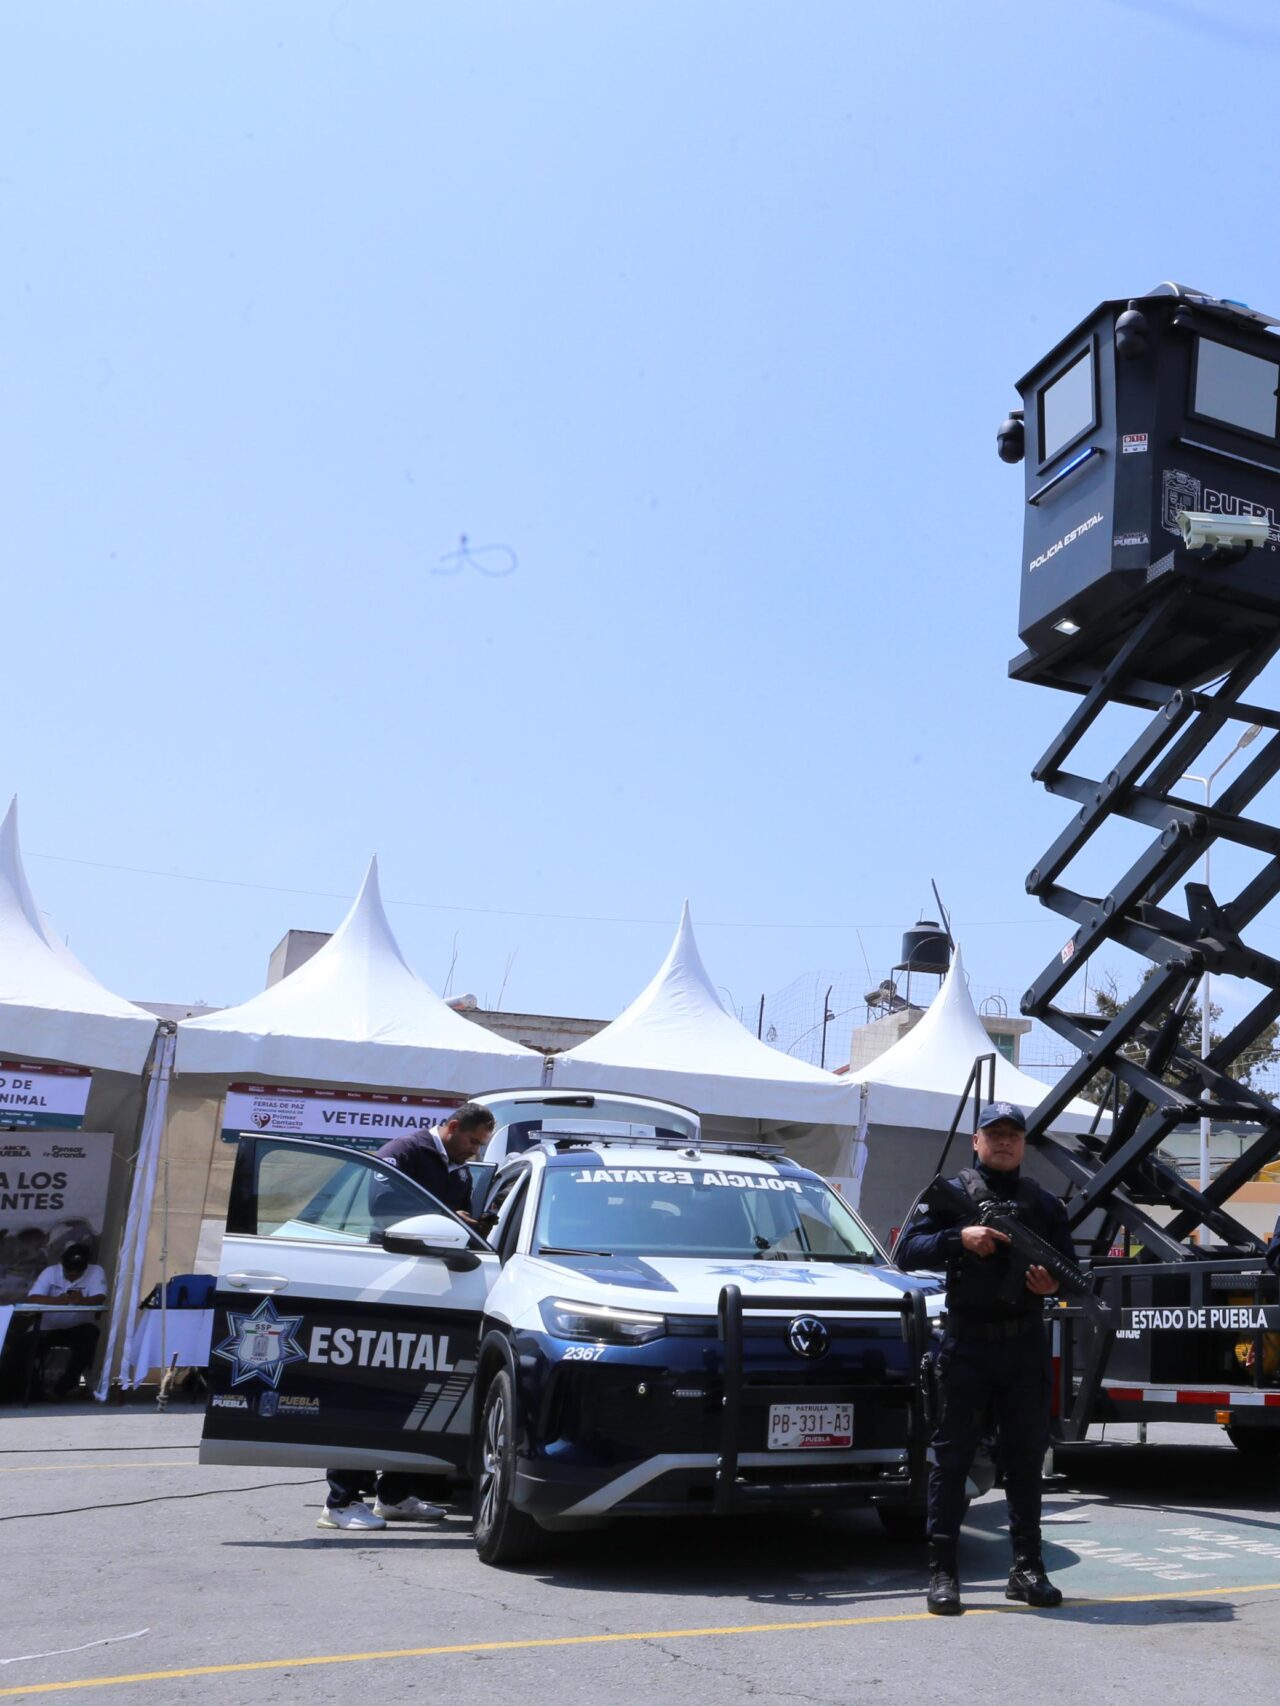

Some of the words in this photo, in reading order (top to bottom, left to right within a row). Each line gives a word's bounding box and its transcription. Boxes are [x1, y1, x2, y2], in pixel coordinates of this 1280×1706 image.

[1029, 540, 1064, 573] POLICIA
[1064, 512, 1104, 546] ESTATAL
[12, 1079, 33, 1090] DE
[18, 1172, 68, 1190] LOS
[1131, 1310, 1184, 1329] ESTADO
[1187, 1309, 1204, 1329] DE
[1210, 1308, 1269, 1328] PUEBLA
[255, 1323, 272, 1331] SSP
[308, 1326, 454, 1372] ESTATAL
[562, 1346, 606, 1361] 2367
[212, 1399, 248, 1409] PUEBLA
[278, 1395, 320, 1406] PUEBLA
[772, 1413, 851, 1434] PB-331-A3
